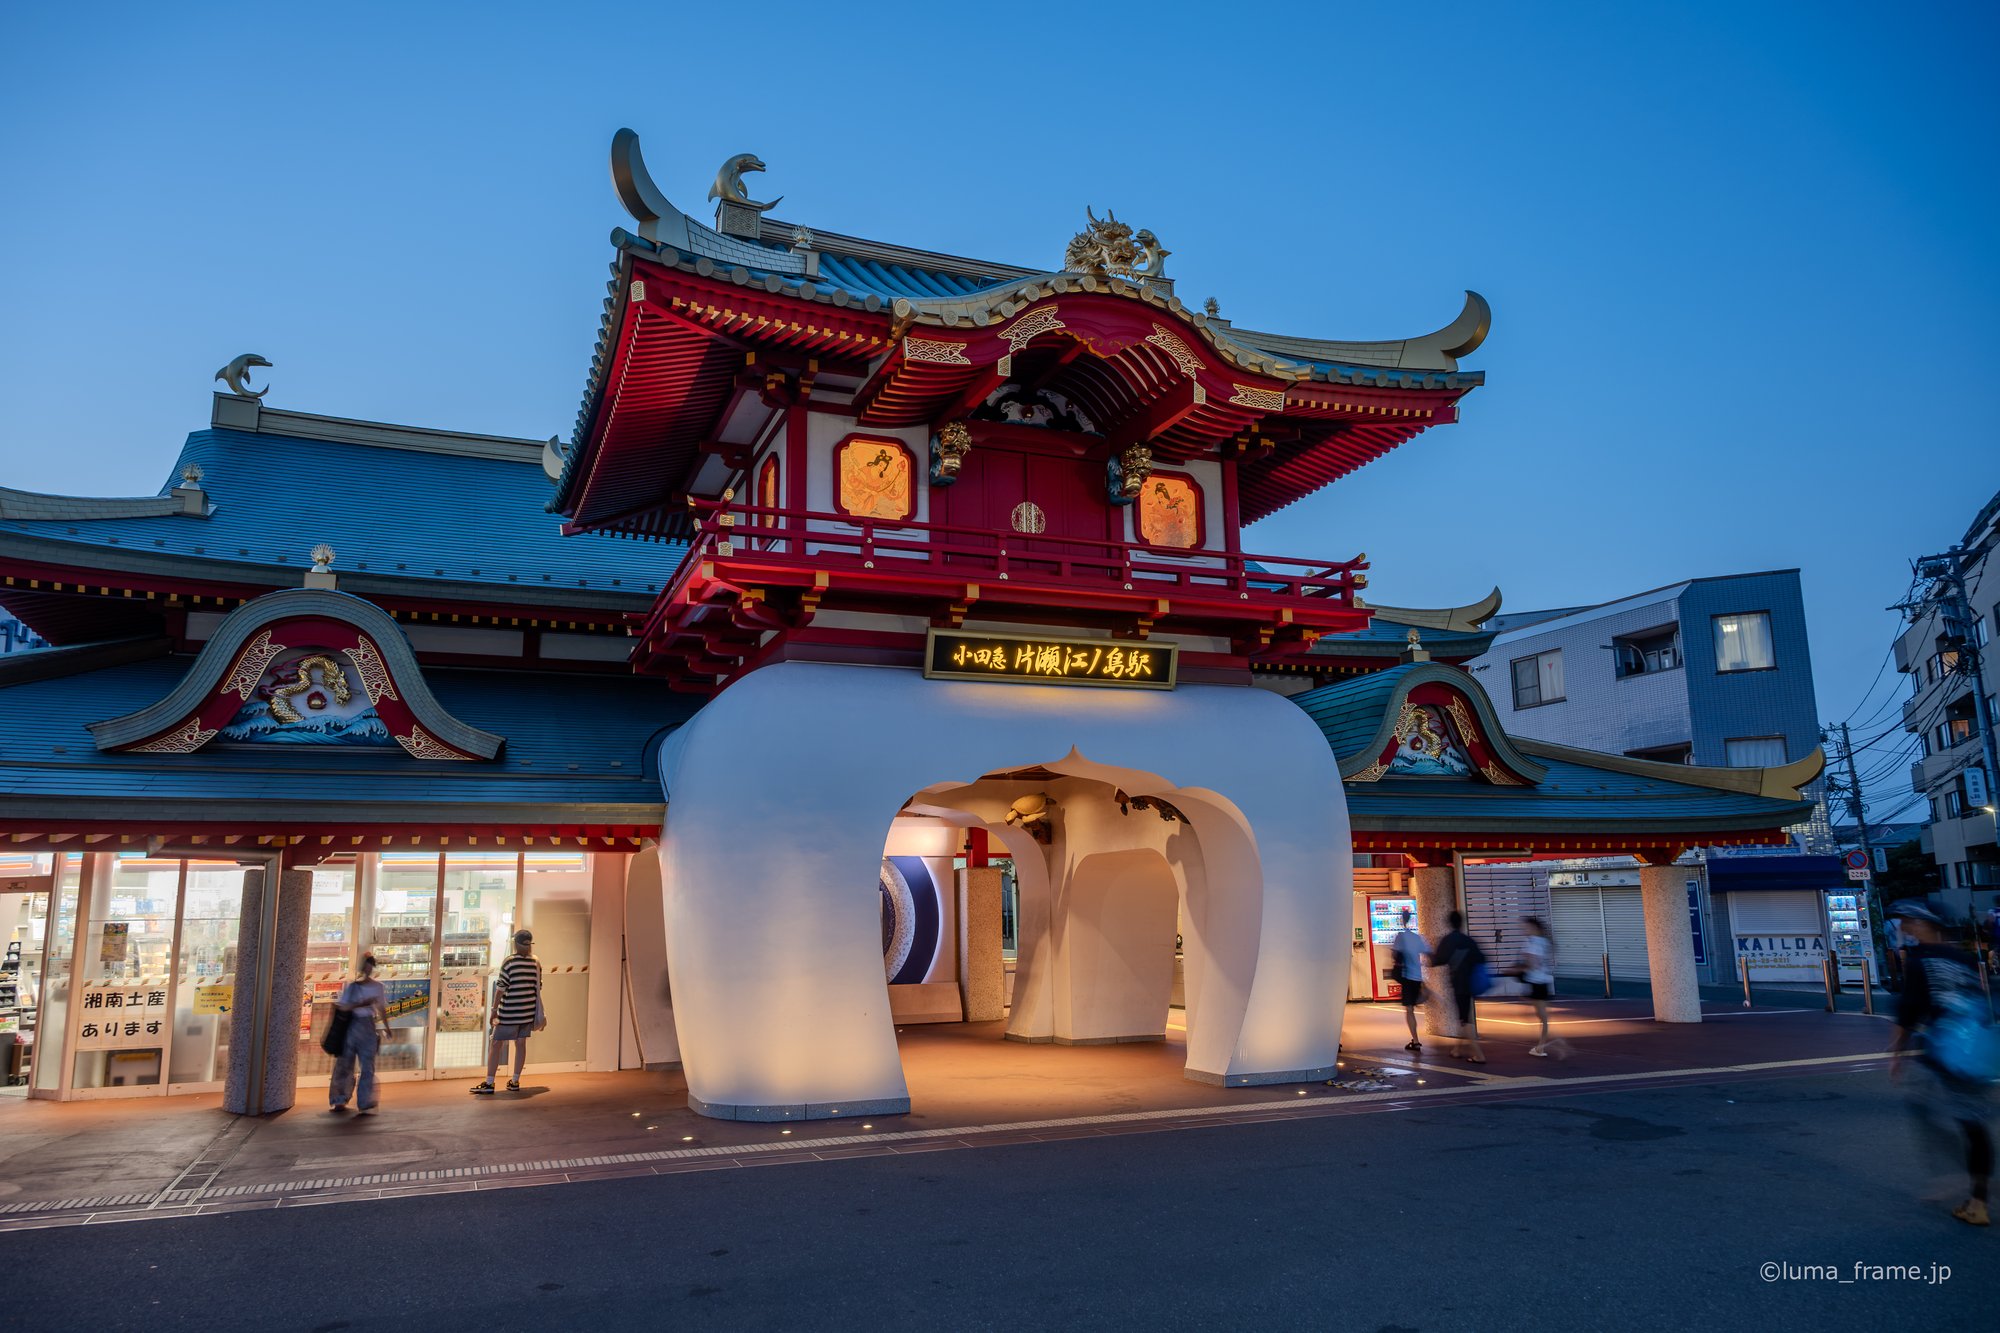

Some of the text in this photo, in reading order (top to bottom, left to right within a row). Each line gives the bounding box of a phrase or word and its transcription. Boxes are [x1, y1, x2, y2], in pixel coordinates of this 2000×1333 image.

[953, 645, 1007, 670] 小田急
[83, 991, 166, 1009] 湘南土産
[81, 1021, 163, 1038] あります
